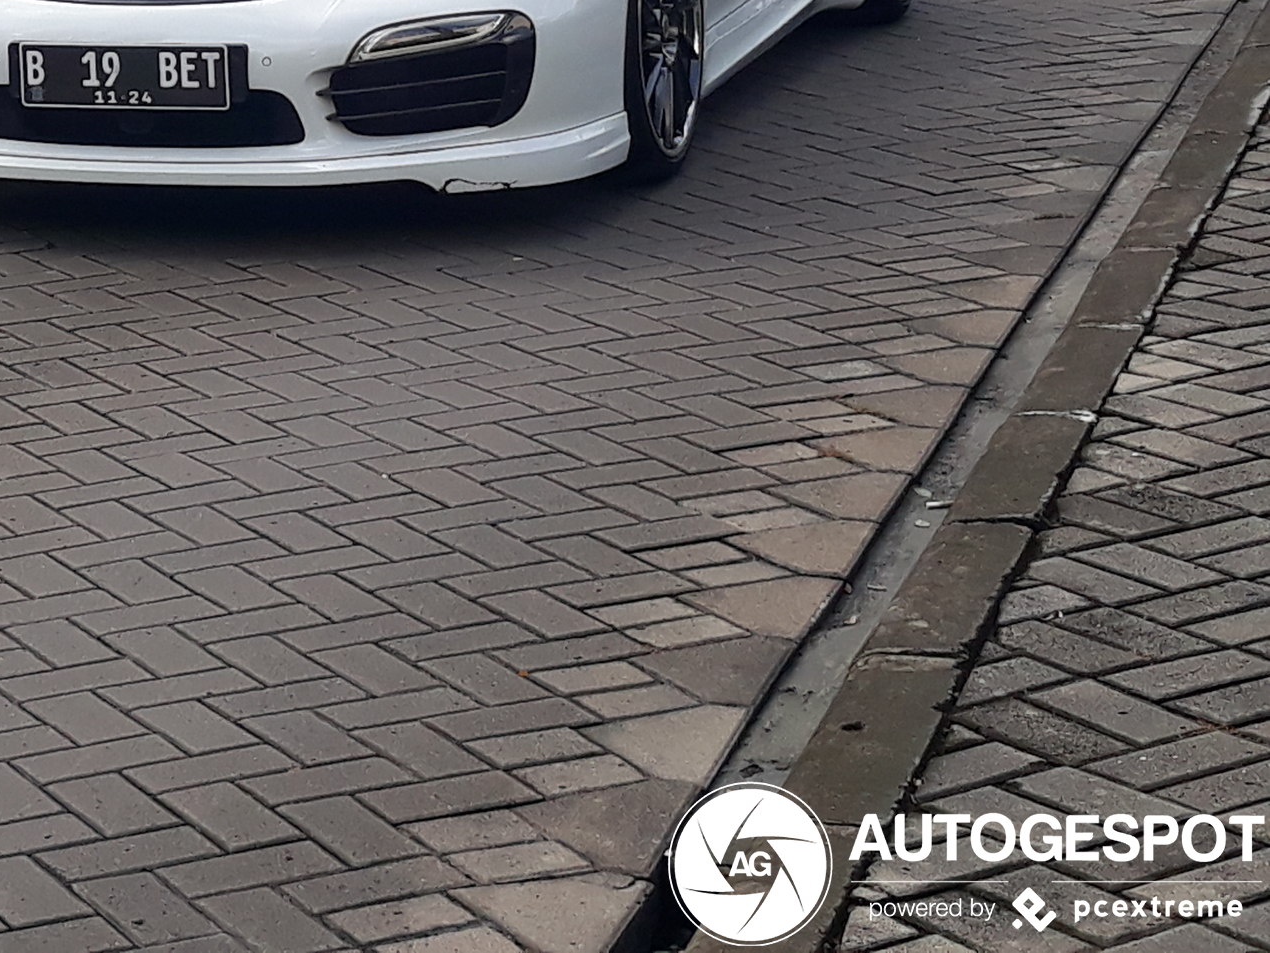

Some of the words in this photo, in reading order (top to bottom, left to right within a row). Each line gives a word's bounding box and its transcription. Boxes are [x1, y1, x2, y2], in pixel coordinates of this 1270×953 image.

[25, 50, 45, 86] B
[80, 51, 121, 88] 19
[158, 51, 220, 88] BET
